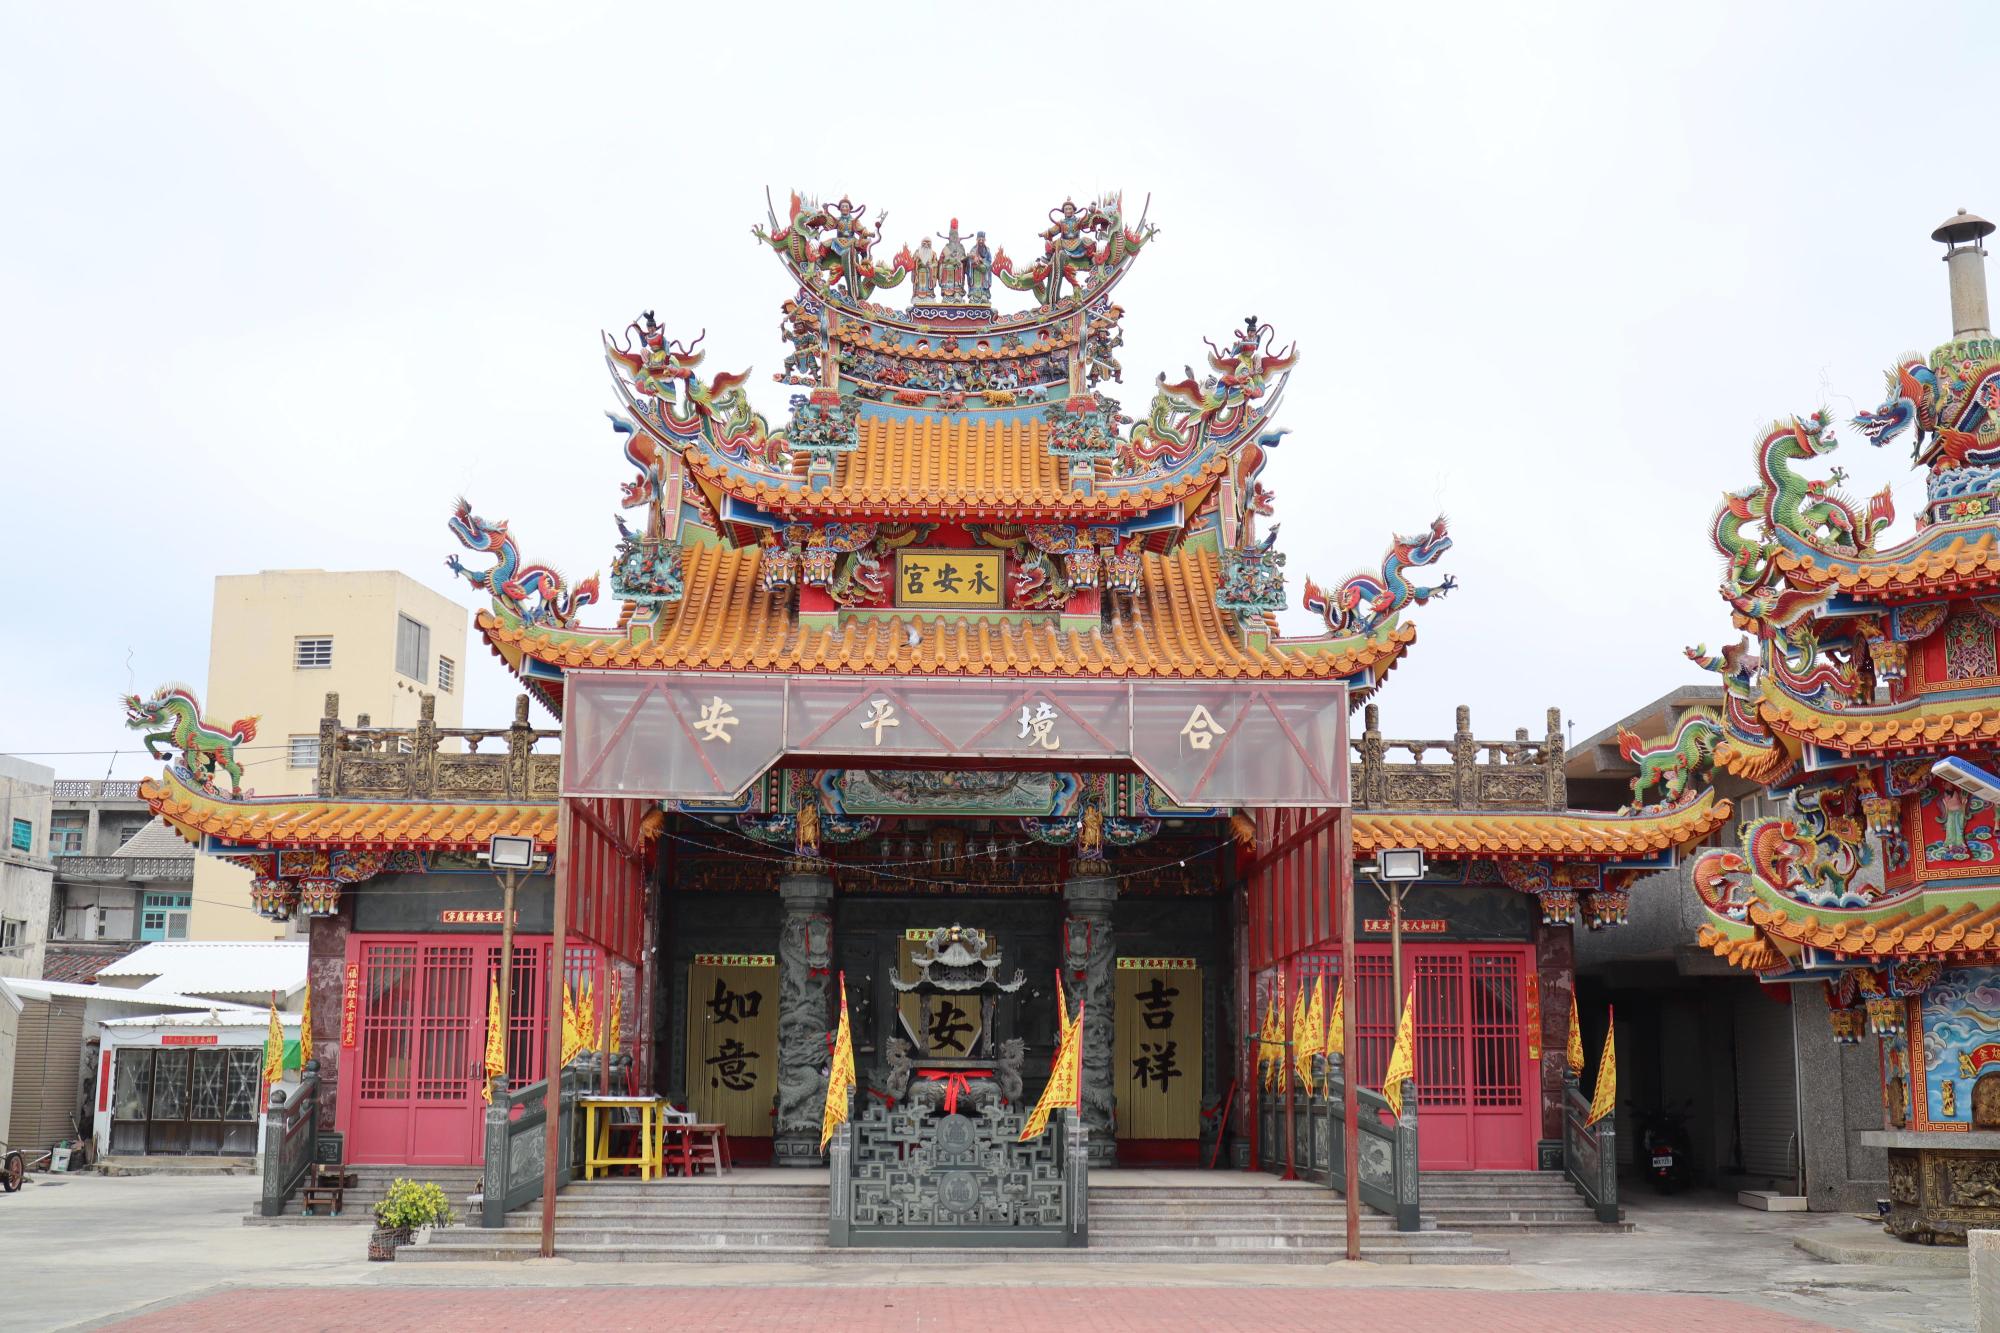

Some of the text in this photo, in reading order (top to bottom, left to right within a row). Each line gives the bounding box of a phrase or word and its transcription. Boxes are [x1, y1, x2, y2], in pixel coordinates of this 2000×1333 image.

[903, 562, 995, 594] 永安宮
[705, 978, 762, 1091] 如意
[1132, 978, 1183, 1094] 吉祥
